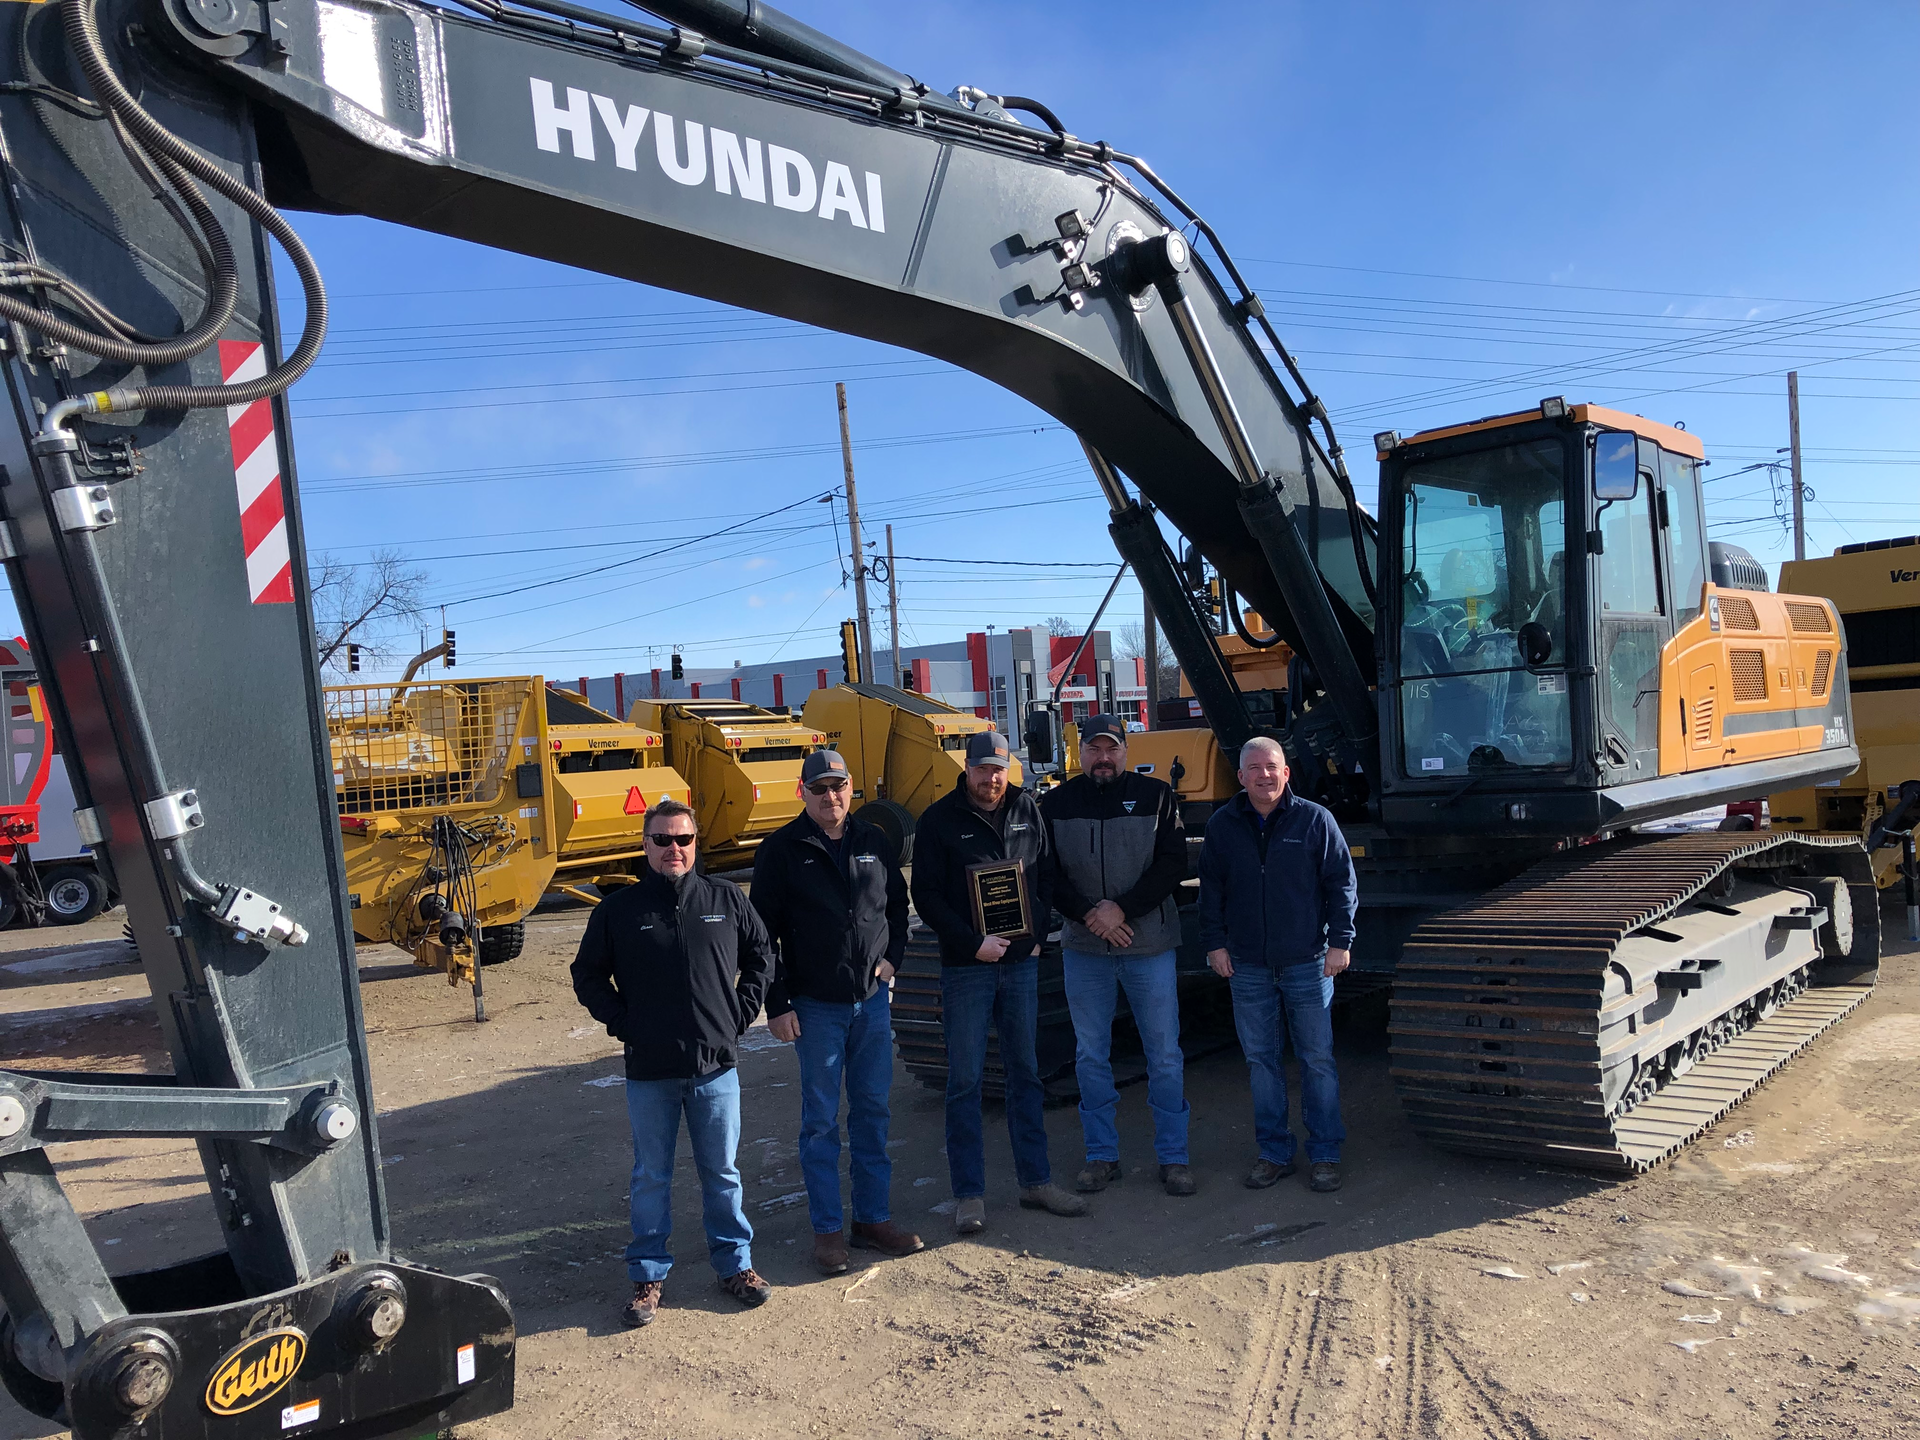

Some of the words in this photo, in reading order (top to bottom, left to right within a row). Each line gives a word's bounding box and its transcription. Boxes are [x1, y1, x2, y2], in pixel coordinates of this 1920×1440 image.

[529, 77, 885, 233] HYUNDAI
[1051, 690, 1085, 699] ONDA
[1410, 683, 1430, 699] 115
[1833, 715, 1844, 728] HX
[588, 739, 620, 748] Vermeer
[764, 737, 791, 745] Vermeer
[214, 1336, 296, 1408] Geith
